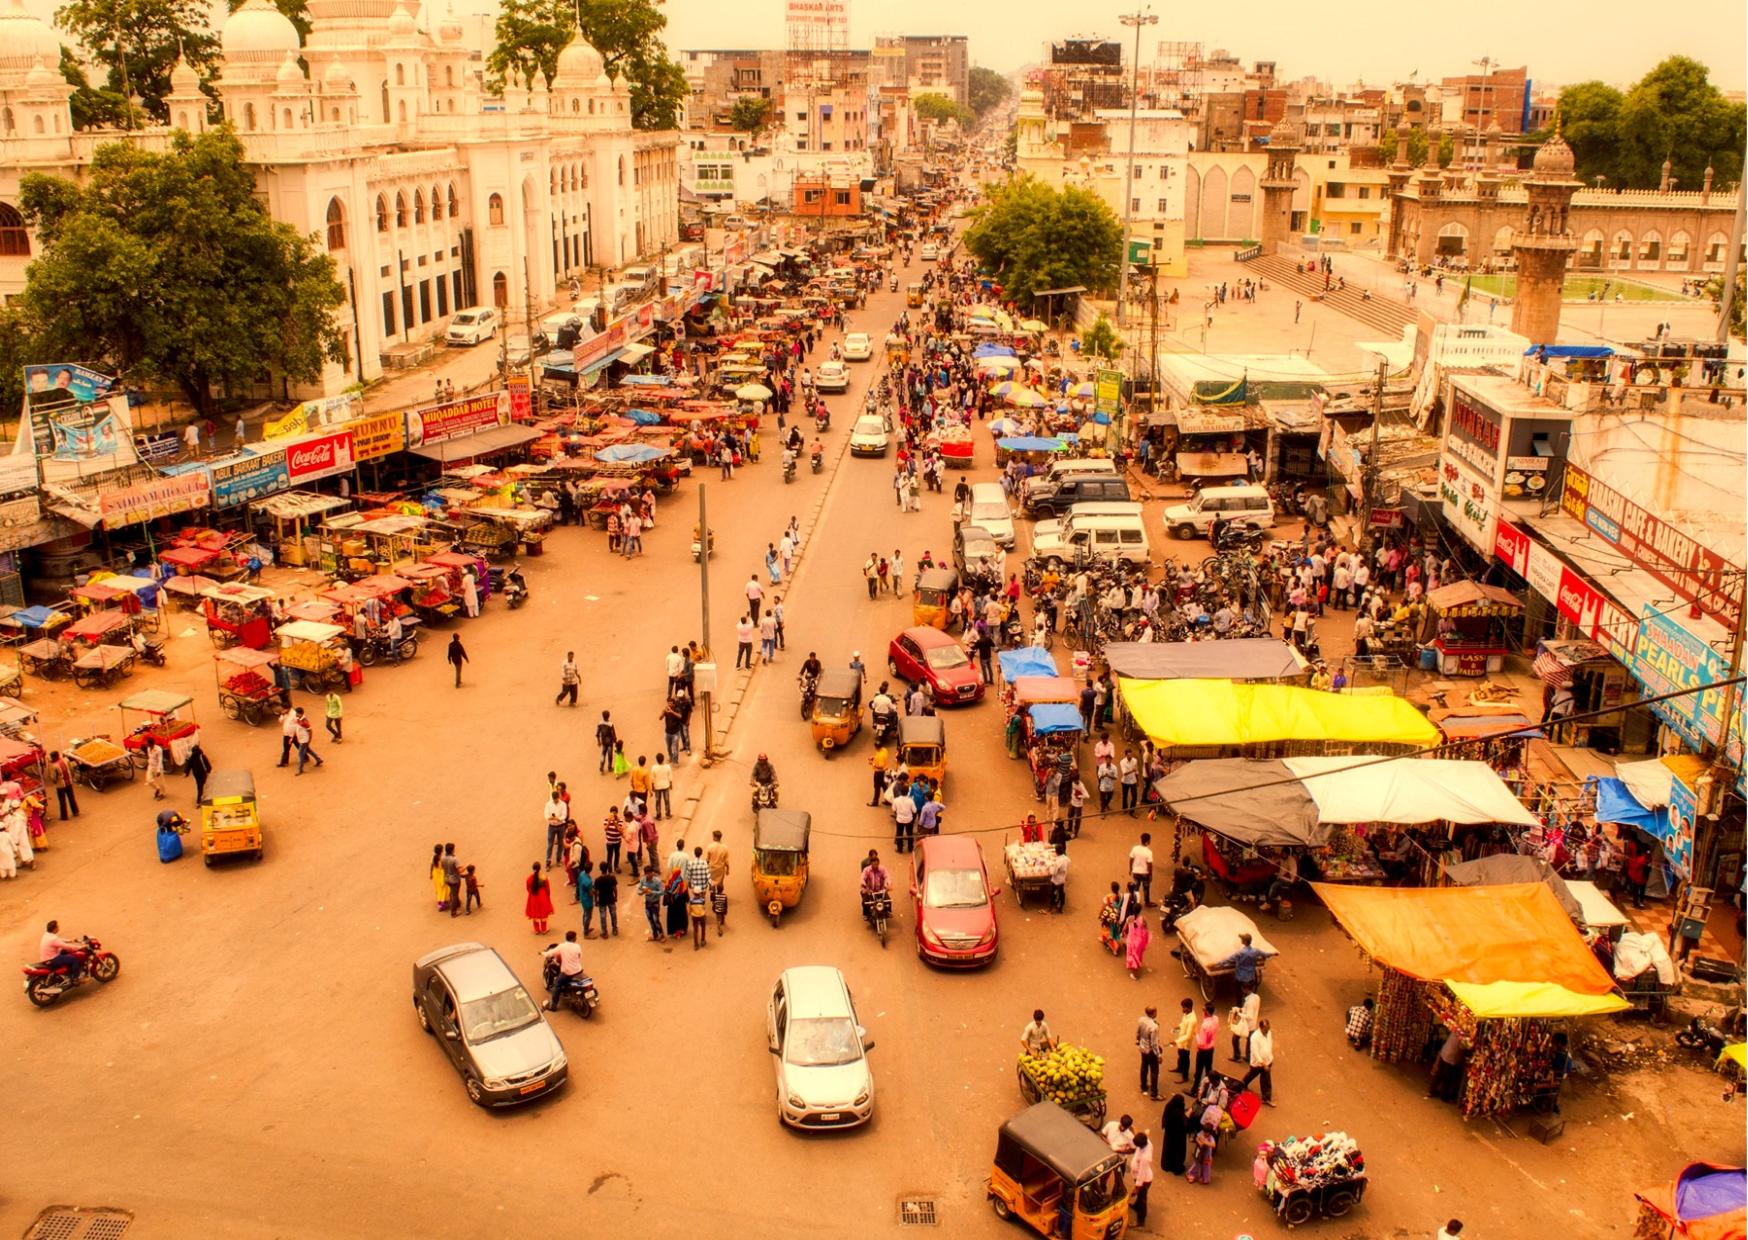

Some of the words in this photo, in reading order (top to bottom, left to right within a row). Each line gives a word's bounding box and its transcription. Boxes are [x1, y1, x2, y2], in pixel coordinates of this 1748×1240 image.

[423, 404, 470, 423] MUQADDAR
[471, 399, 497, 412] HOTEL
[1455, 400, 1500, 451] NIMRAH
[349, 416, 398, 438] MUNNU
[215, 466, 233, 481] ABUL
[261, 449, 287, 468] BAKERY
[292, 443, 331, 469] Coca-Cola
[1623, 501, 1649, 541] CAFE
[1645, 520, 1655, 545] &
[1653, 518, 1698, 572] BAKERY
[1560, 584, 1583, 615] Coca-Cola
[1638, 634, 1700, 699] PEARLS
